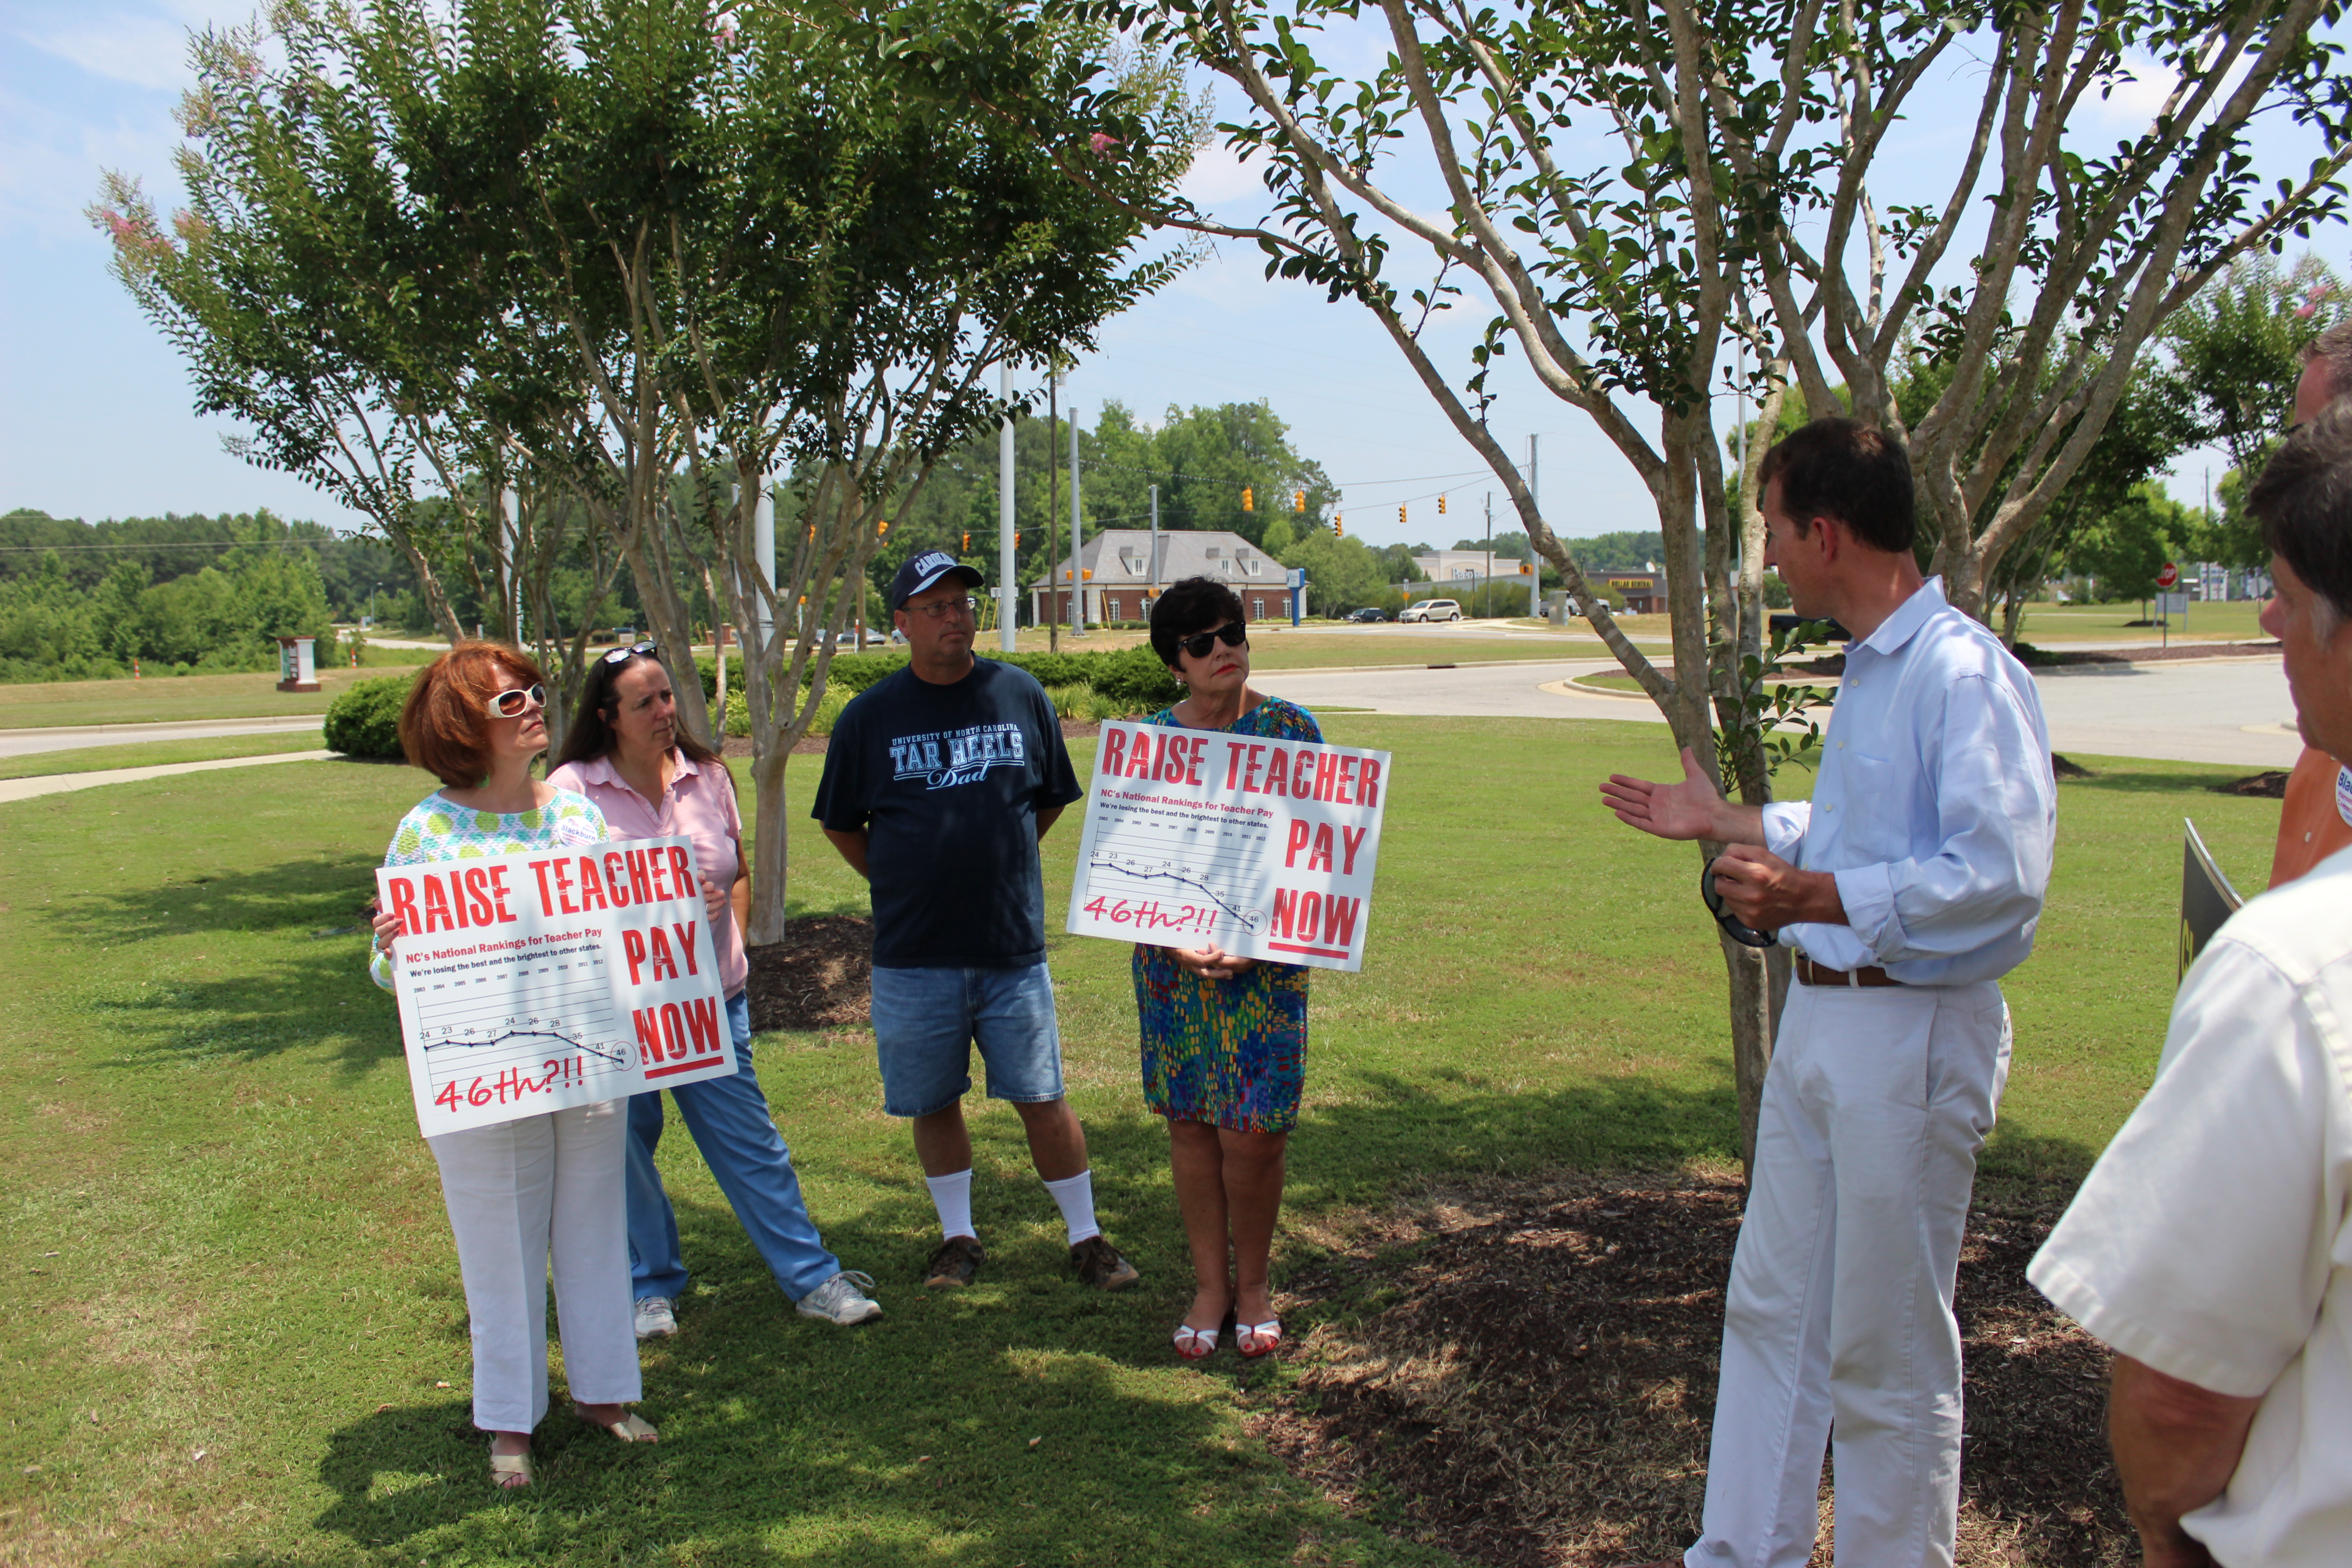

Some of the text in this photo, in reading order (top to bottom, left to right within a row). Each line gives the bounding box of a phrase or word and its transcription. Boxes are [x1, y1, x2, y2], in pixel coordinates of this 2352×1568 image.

[889, 732, 1024, 774] TAR HEELS
[892, 732, 940, 745] UNIVERSITY
[956, 725, 980, 737] NORTH
[926, 759, 991, 790] Dad
[1102, 728, 1382, 808] RAISE TEACHER
[1101, 789, 1274, 818] NC's National Rankings for Teacher Pay
[1119, 804, 1138, 813] losing
[1191, 813, 1220, 822] brightest
[561, 824, 596, 842] Blackburn
[1285, 818, 1366, 876] PAY
[388, 845, 696, 938] RAISE TEACHER
[1270, 887, 1360, 947] NOW
[406, 928, 602, 964] NC's National Rankings for Teacher Pay
[410, 969, 431, 977] We're
[433, 965, 456, 974] losing
[471, 960, 487, 968] best
[489, 957, 503, 965] and
[517, 950, 549, 961] brightest
[559, 946, 577, 955] other
[579, 943, 602, 952] states.
[622, 920, 697, 986] PAY
[419, 1031, 430, 1039] 24
[441, 1026, 453, 1034] 23
[505, 1017, 515, 1025] 24
[528, 1017, 539, 1025] 26
[550, 1019, 560, 1028] 28
[632, 995, 721, 1066] NOW
